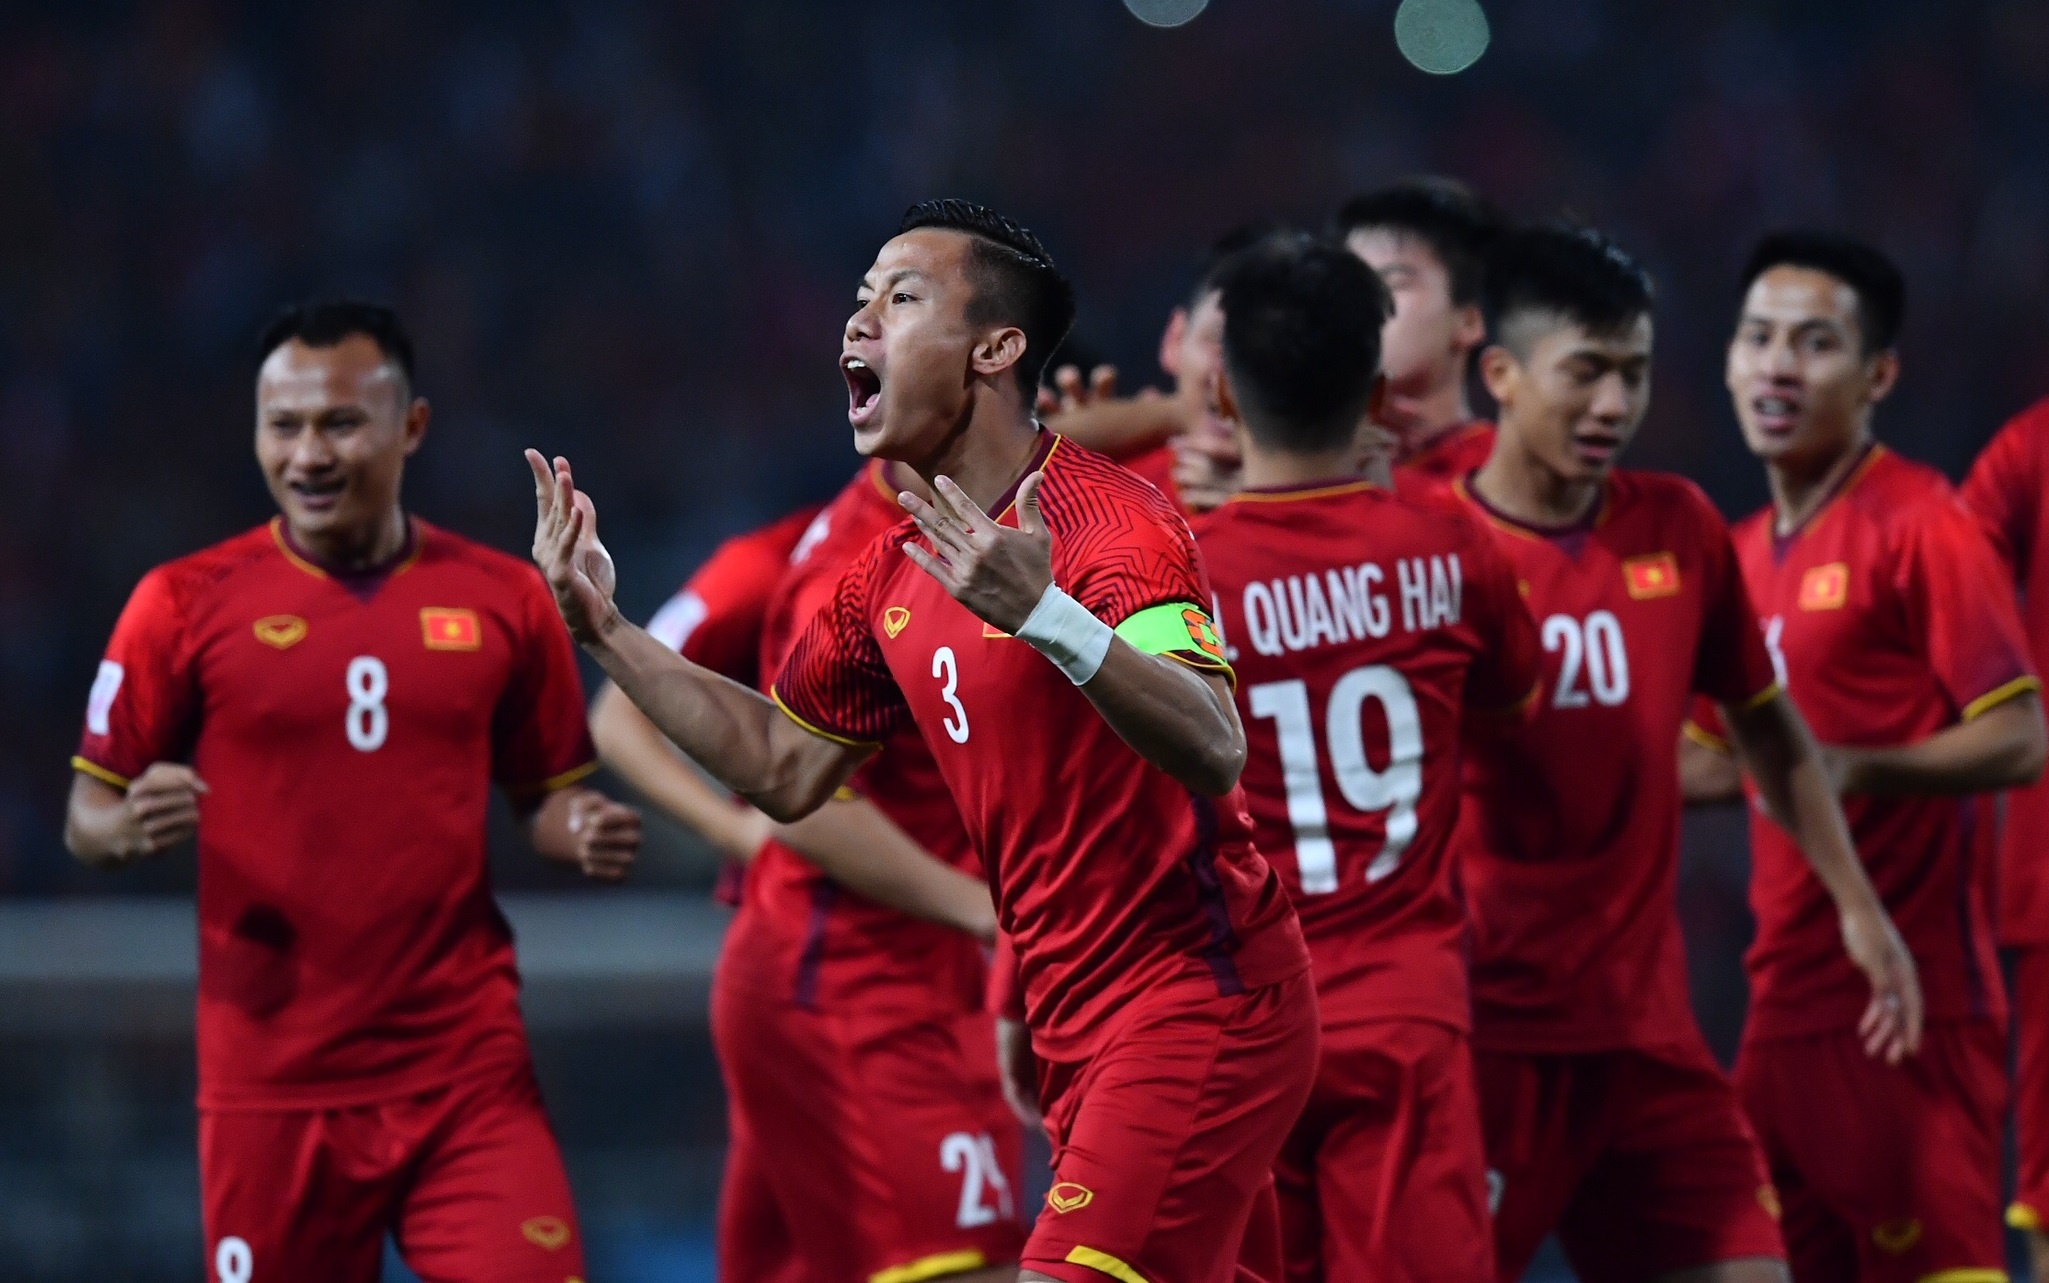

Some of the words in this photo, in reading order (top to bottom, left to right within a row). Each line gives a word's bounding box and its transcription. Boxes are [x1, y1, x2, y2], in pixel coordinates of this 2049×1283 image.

[1243, 563, 1390, 656] QUANG
[1397, 553, 1462, 631] HAI
[346, 656, 388, 751] 8
[932, 646, 969, 744] 3
[1542, 610, 1629, 707] 20
[1248, 665, 1424, 894] 19
